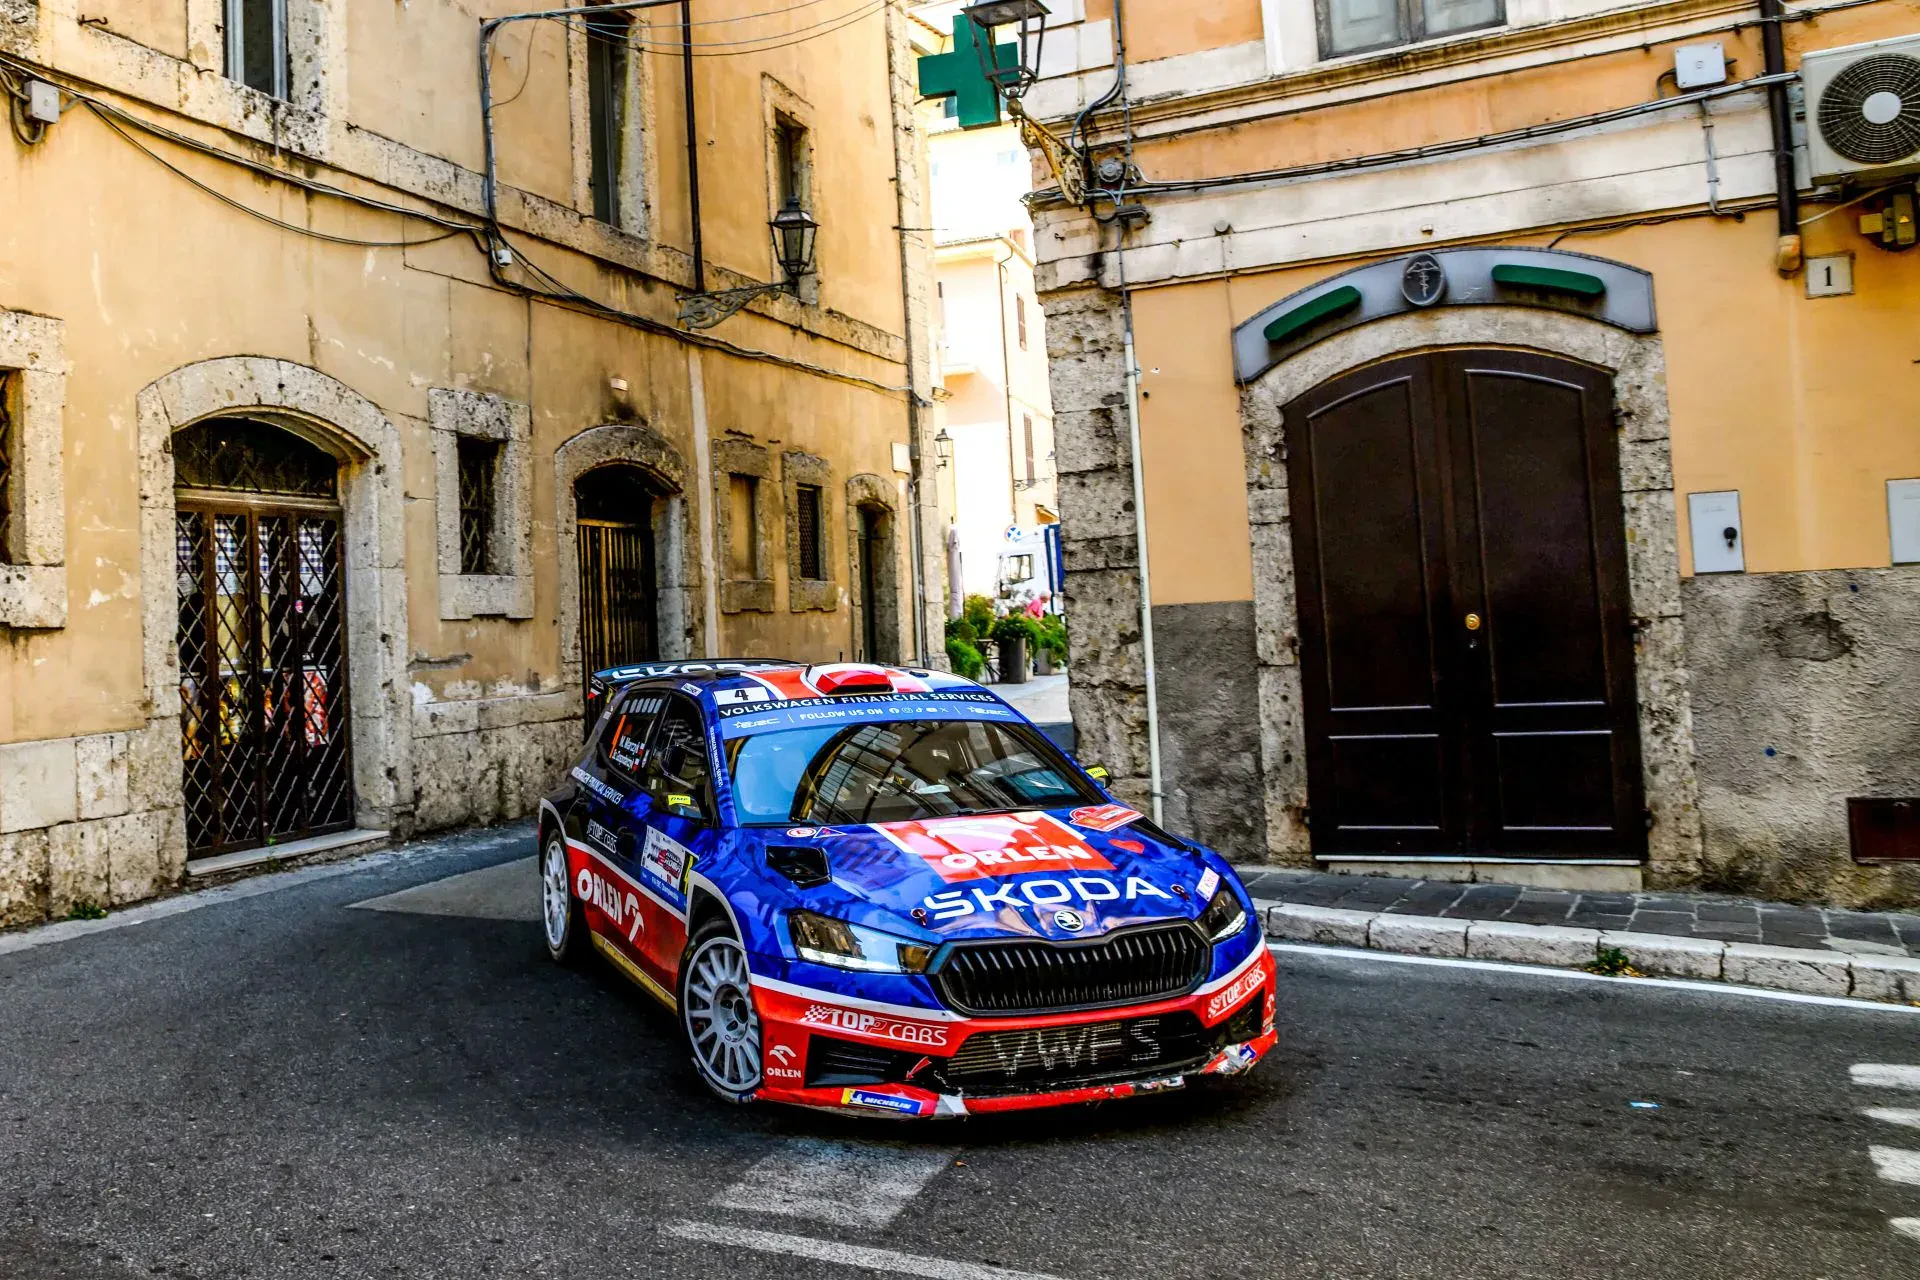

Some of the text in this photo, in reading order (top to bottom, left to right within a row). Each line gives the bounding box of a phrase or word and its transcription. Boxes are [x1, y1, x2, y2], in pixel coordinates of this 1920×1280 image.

[1824, 265, 1832, 287] 1
[720, 693, 996, 717] VOLKSWAGEN FINANCIAL SERVICES
[734, 689, 749, 701] 4
[800, 710, 845, 720] FOLLOW
[848, 708, 864, 717] US
[866, 708, 883, 716] ON
[941, 845, 1093, 869] ORLEN
[577, 868, 622, 926] ORLEN
[1221, 967, 1267, 1008] TOP CARS
[830, 1009, 948, 1047] TOP CARS
[766, 1067, 802, 1079] ORLEN
[863, 1096, 912, 1110] MICHELIN
